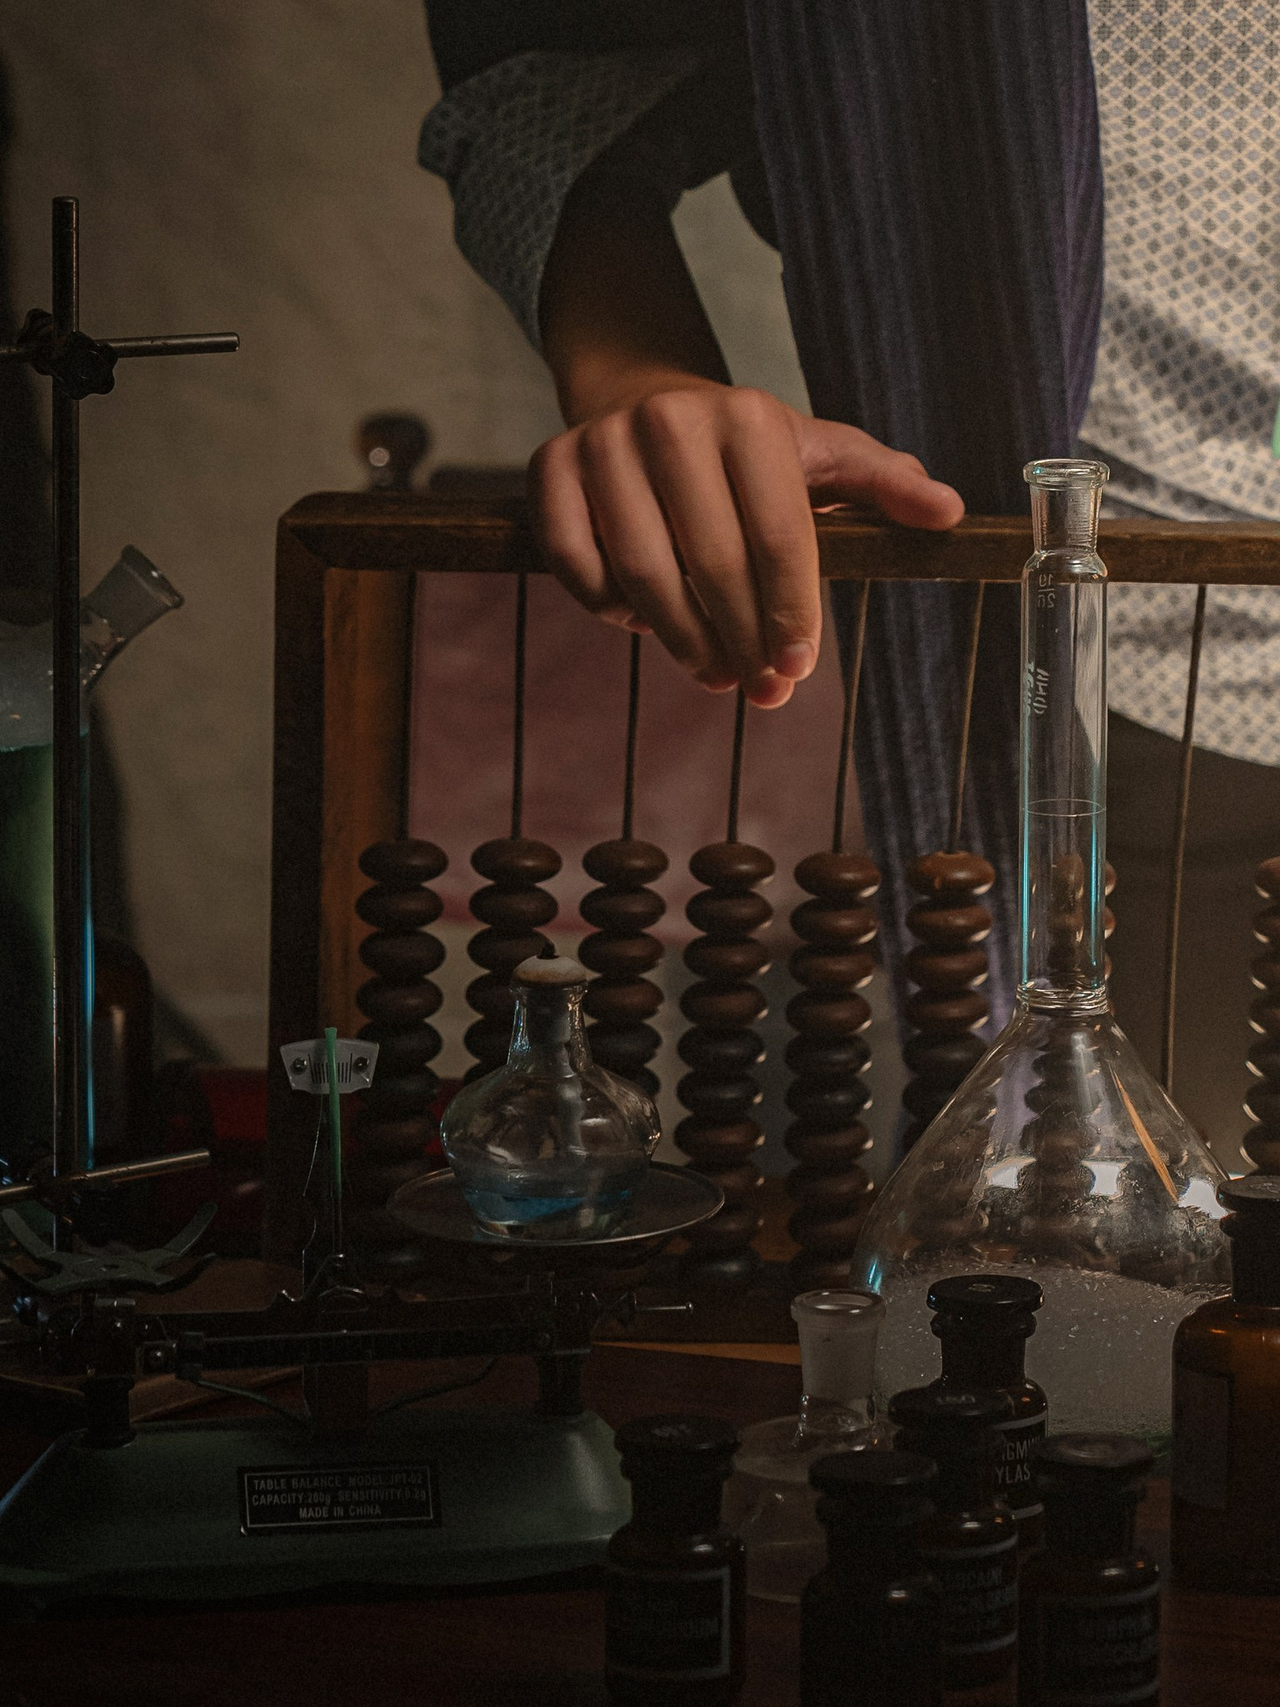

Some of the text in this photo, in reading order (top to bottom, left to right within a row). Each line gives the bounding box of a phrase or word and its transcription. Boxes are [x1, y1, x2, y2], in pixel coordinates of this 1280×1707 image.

[253, 1478, 287, 1491] TABLE
[291, 1475, 342, 1489] BALANCE
[299, 1504, 382, 1519] MADE IN CHINA
